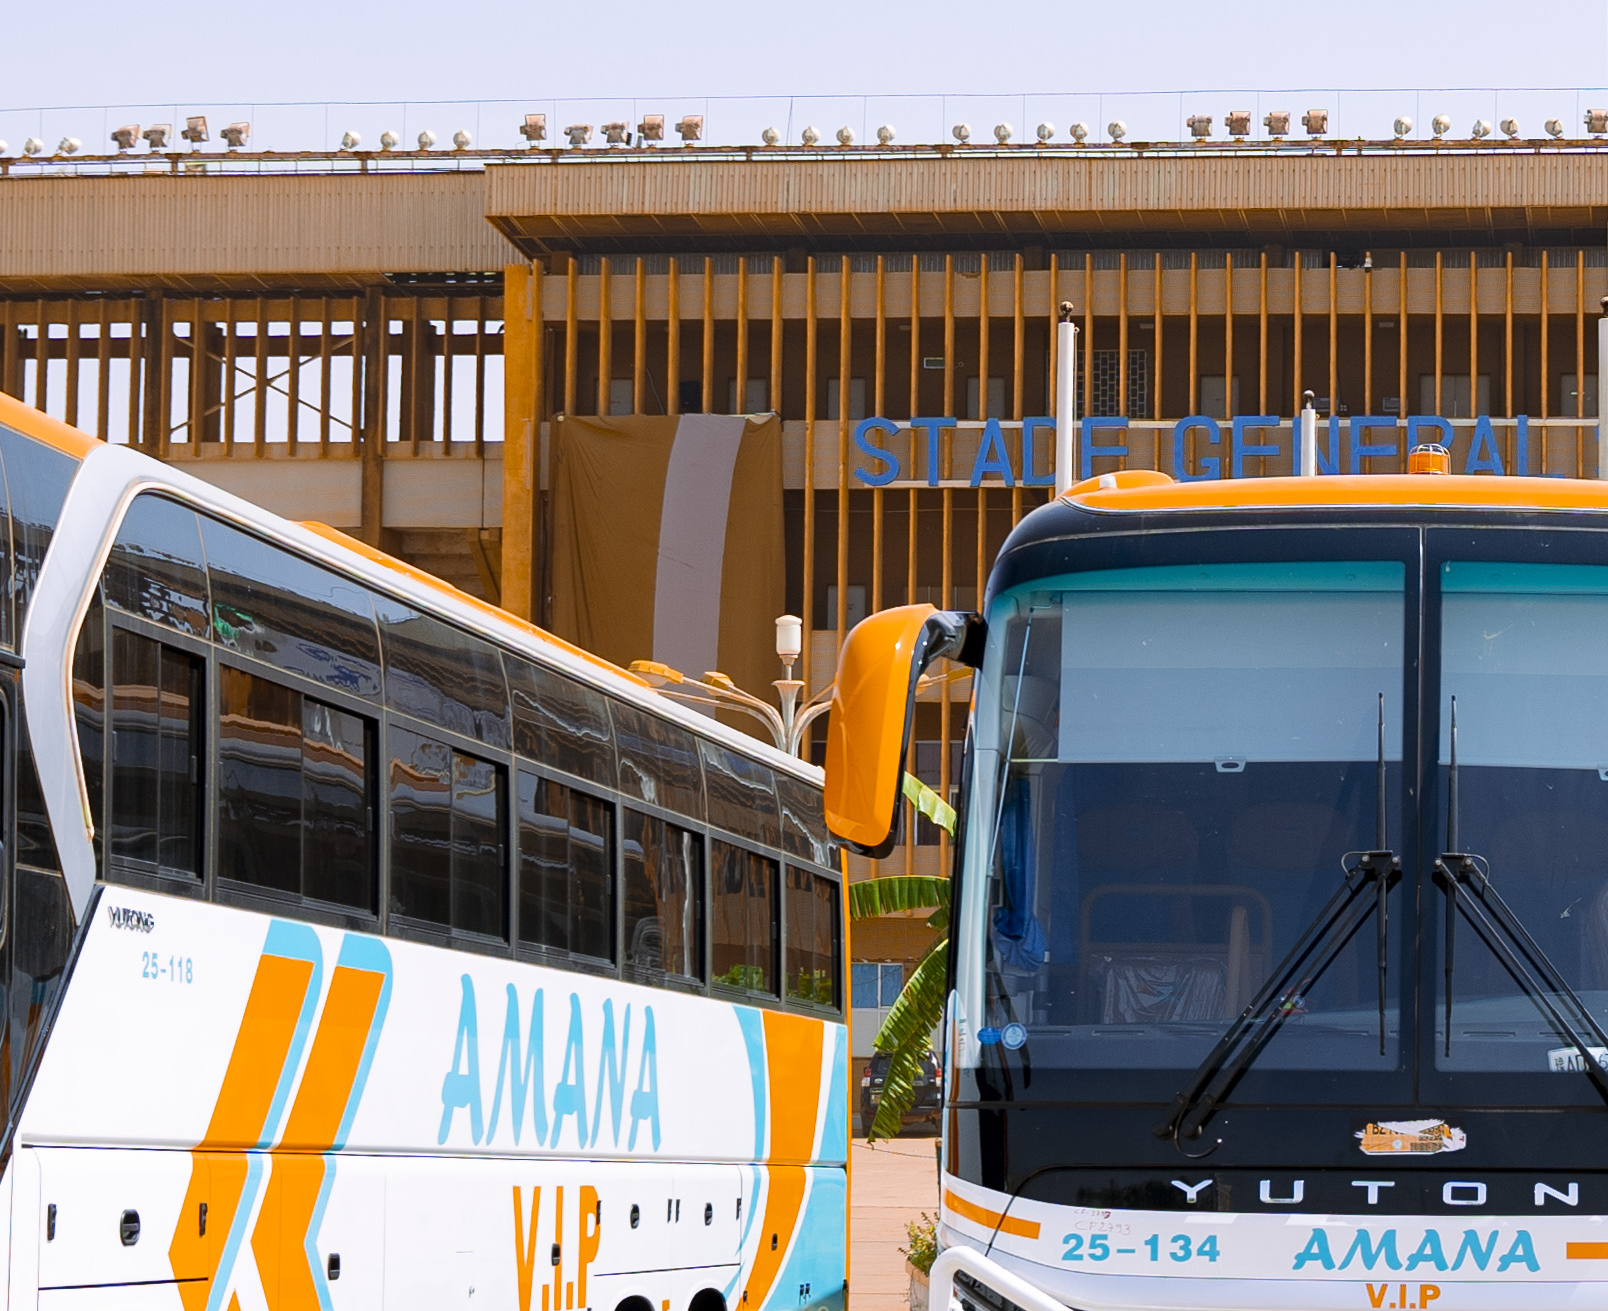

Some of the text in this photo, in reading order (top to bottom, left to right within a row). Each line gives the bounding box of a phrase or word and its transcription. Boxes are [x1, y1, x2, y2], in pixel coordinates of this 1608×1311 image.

[853, 416, 1130, 487] STADE
[142, 951, 193, 984] 25-118
[438, 972, 661, 1152] AMANA
[1061, 1228, 1542, 1274] 25-134 AMANA
[1366, 1283, 1442, 1311] V.I.P
